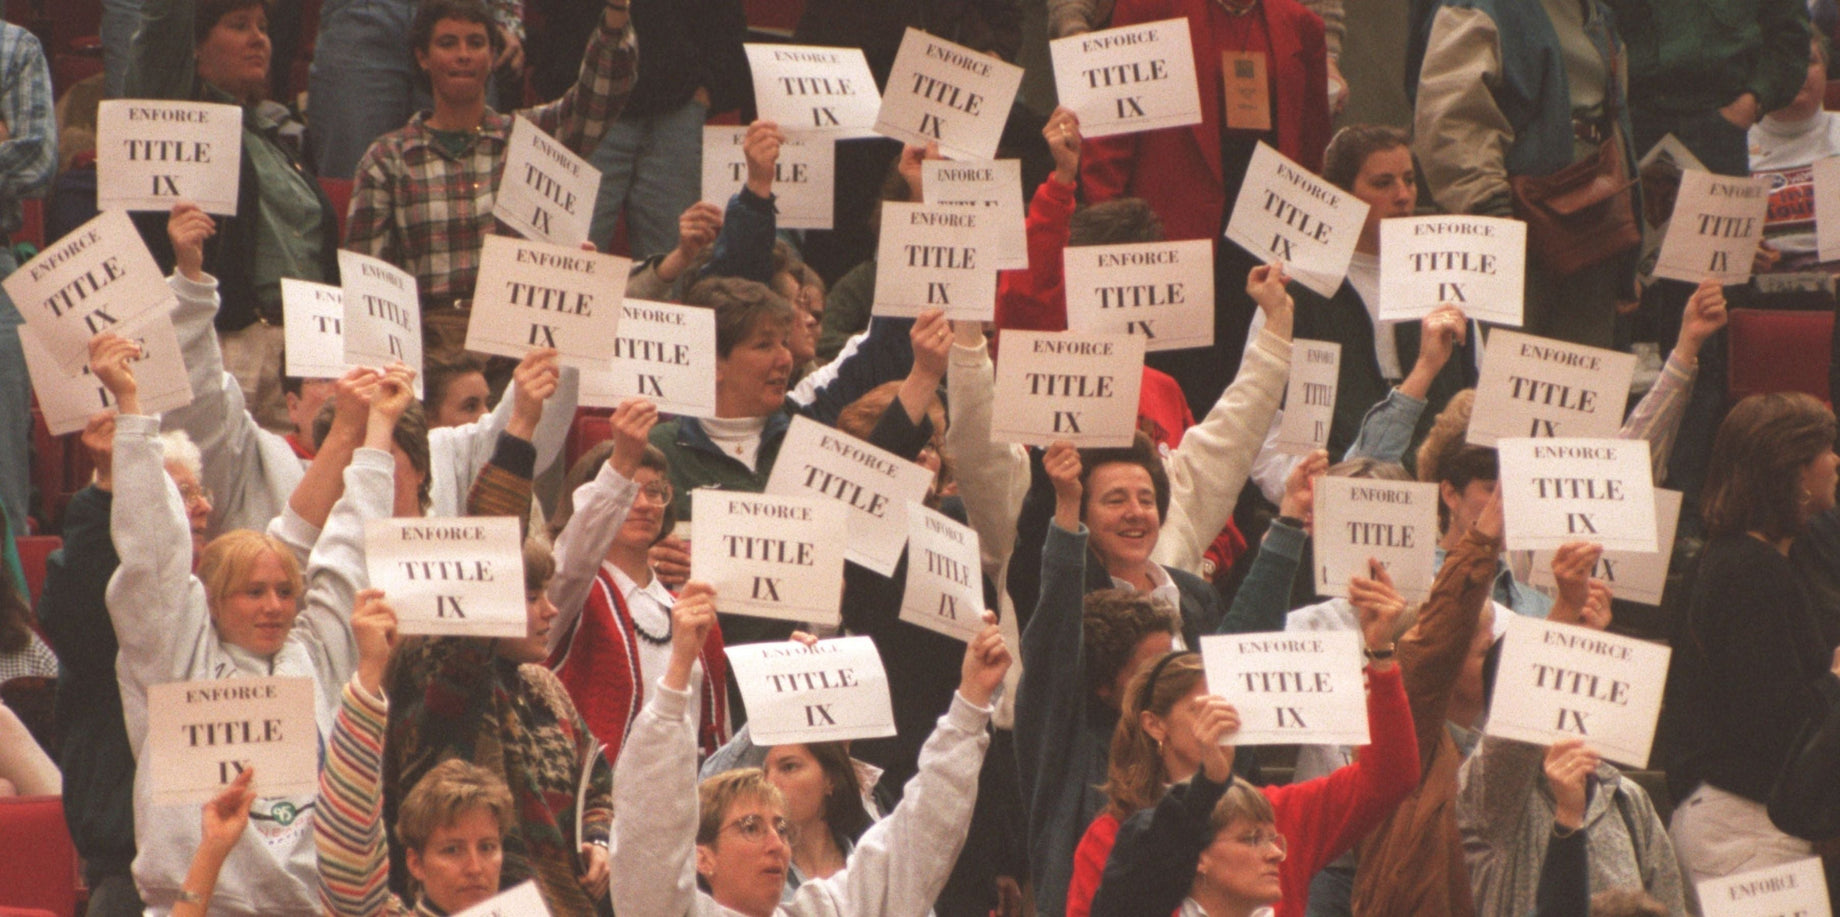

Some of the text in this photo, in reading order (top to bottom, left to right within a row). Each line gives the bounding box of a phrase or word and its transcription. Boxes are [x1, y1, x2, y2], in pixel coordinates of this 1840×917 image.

[1082, 30, 1159, 53] ENFORCE
[774, 51, 840, 64] ENFORCE
[926, 44, 991, 78] ENFORCE
[778, 76, 856, 96] TITLE
[1082, 59, 1168, 89] TITLE
[913, 72, 983, 116] TITLE
[129, 108, 208, 124] ENFORCE
[812, 107, 840, 127] IX
[1116, 96, 1145, 118] IX
[919, 113, 946, 139] IX
[124, 139, 211, 164] TITLE
[533, 136, 580, 178] ENFORCE
[728, 163, 808, 183] TLE
[937, 169, 994, 181] ENFORCE
[152, 175, 180, 196] IX
[524, 162, 576, 215] TITLE
[1276, 163, 1339, 209] ENFORCE
[532, 207, 551, 234] IX
[910, 212, 976, 228] ENFORCE
[1264, 188, 1333, 245] TITLE
[1698, 213, 1756, 237] TITLE
[1414, 223, 1495, 237] ENFORCE
[31, 229, 101, 281] ENFORCE
[904, 244, 976, 269] TITLE
[1098, 250, 1179, 267] ENFORCE
[1269, 234, 1297, 262] IX
[516, 249, 595, 275] ENFORCE
[1410, 251, 1497, 275] TITLE
[1710, 251, 1728, 272] IX
[44, 257, 125, 317] TITLE
[361, 264, 404, 291] ENFORCE
[506, 282, 594, 317] TITLE
[927, 283, 950, 304] IX
[1095, 283, 1184, 309] TITLE
[1438, 283, 1467, 303] IX
[84, 303, 117, 334] IX
[363, 294, 411, 332] TITLE
[622, 305, 686, 325] NFORCE
[529, 324, 557, 348] IX
[1126, 320, 1156, 340] IX
[614, 336, 690, 366] TITLE
[1033, 340, 1113, 356] ENFORCE
[1520, 343, 1600, 371] ENFORCE
[638, 374, 664, 397] IX
[1026, 373, 1113, 398] TITLE
[1303, 383, 1332, 406] TITLE
[1508, 375, 1598, 413] TITLE
[1053, 411, 1082, 433] IX
[1530, 418, 1561, 437] IX
[820, 436, 899, 479] ENFORCE
[1534, 446, 1617, 461] ENFORCE
[804, 464, 889, 518] TITLE
[1351, 487, 1413, 504] ENFORCE
[1532, 478, 1625, 501] TITLE
[728, 501, 813, 521] ENFORCE
[401, 526, 485, 541] ENFORCE
[925, 516, 965, 544] ENFORCE
[1347, 521, 1415, 548] TITLE
[1567, 513, 1599, 534] IX
[722, 535, 814, 567] TITLE
[398, 561, 494, 581] TITLE
[925, 548, 972, 588] TITLE
[1590, 558, 1618, 582] IX
[752, 577, 782, 602] IX
[437, 595, 465, 618] IX
[939, 592, 958, 620] IX
[762, 645, 841, 658] ENFORCE
[1238, 640, 1324, 654] ENFORCE
[1543, 630, 1634, 661] ENFORCE
[766, 668, 858, 692] TITLE
[1238, 672, 1333, 694] TITLE
[1532, 663, 1630, 707] TITLE
[186, 685, 277, 703] ENFORCE
[804, 704, 836, 726] IX
[1275, 707, 1306, 728] IX
[1555, 708, 1590, 736] IX
[182, 719, 283, 747] TITLE
[1729, 873, 1798, 901] ENFORCE
